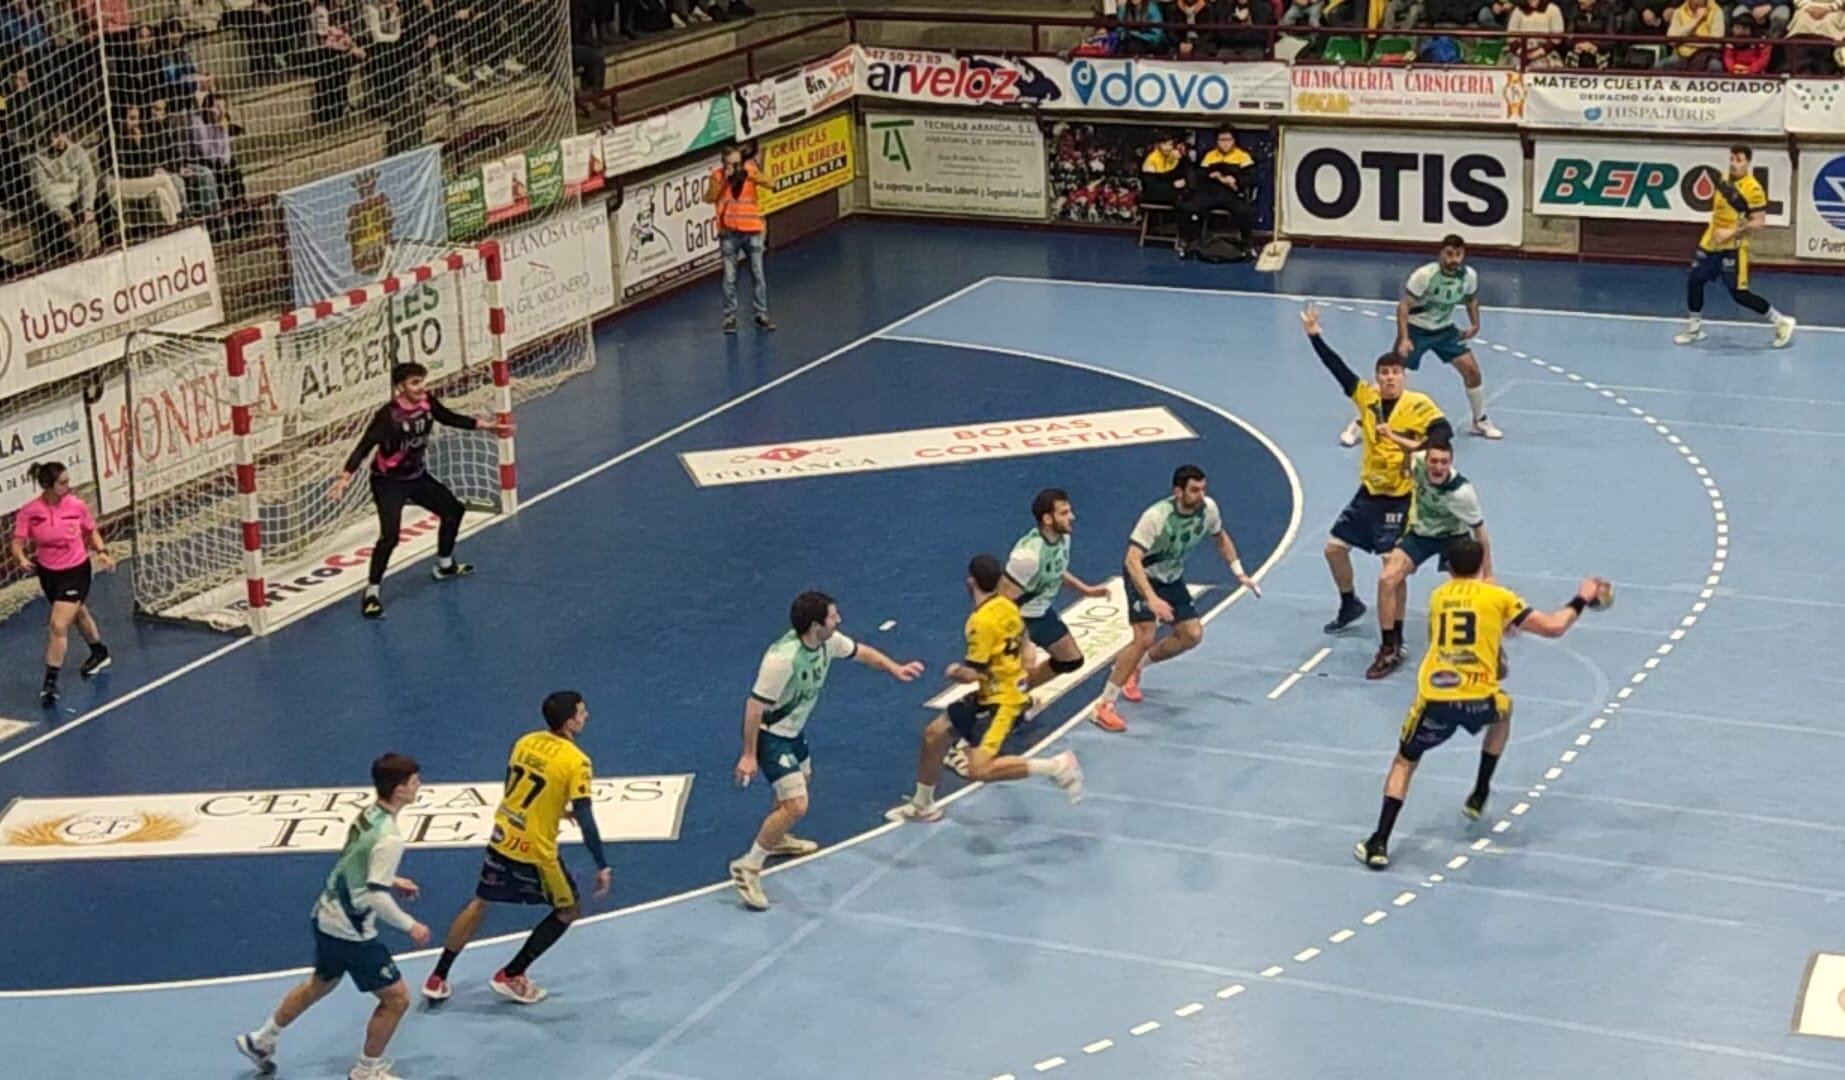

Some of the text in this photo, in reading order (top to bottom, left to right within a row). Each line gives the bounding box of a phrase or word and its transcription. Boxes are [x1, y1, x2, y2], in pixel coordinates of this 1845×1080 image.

[867, 58, 1018, 100] arveloz
[1100, 62, 1229, 110] dovo
[1404, 70, 1494, 95] CARNICERÍA
[1533, 76, 1784, 95] MATEOS CUESTA & ASOCIADOS
[1658, 95, 1721, 105] ABOGADOS
[771, 128, 828, 159] GRÁFICAS
[771, 141, 847, 177] DE LA RIBERA
[775, 157, 844, 193] IMPRENTA
[1295, 147, 1509, 227] OTIS
[20, 256, 208, 343] tubos aranda
[300, 317, 442, 404] ALBERTO
[98, 353, 279, 479] MONELA
[953, 417, 1093, 441] BODAS
[913, 425, 1165, 460] CON ESTILO
[1437, 611, 1476, 647] 13
